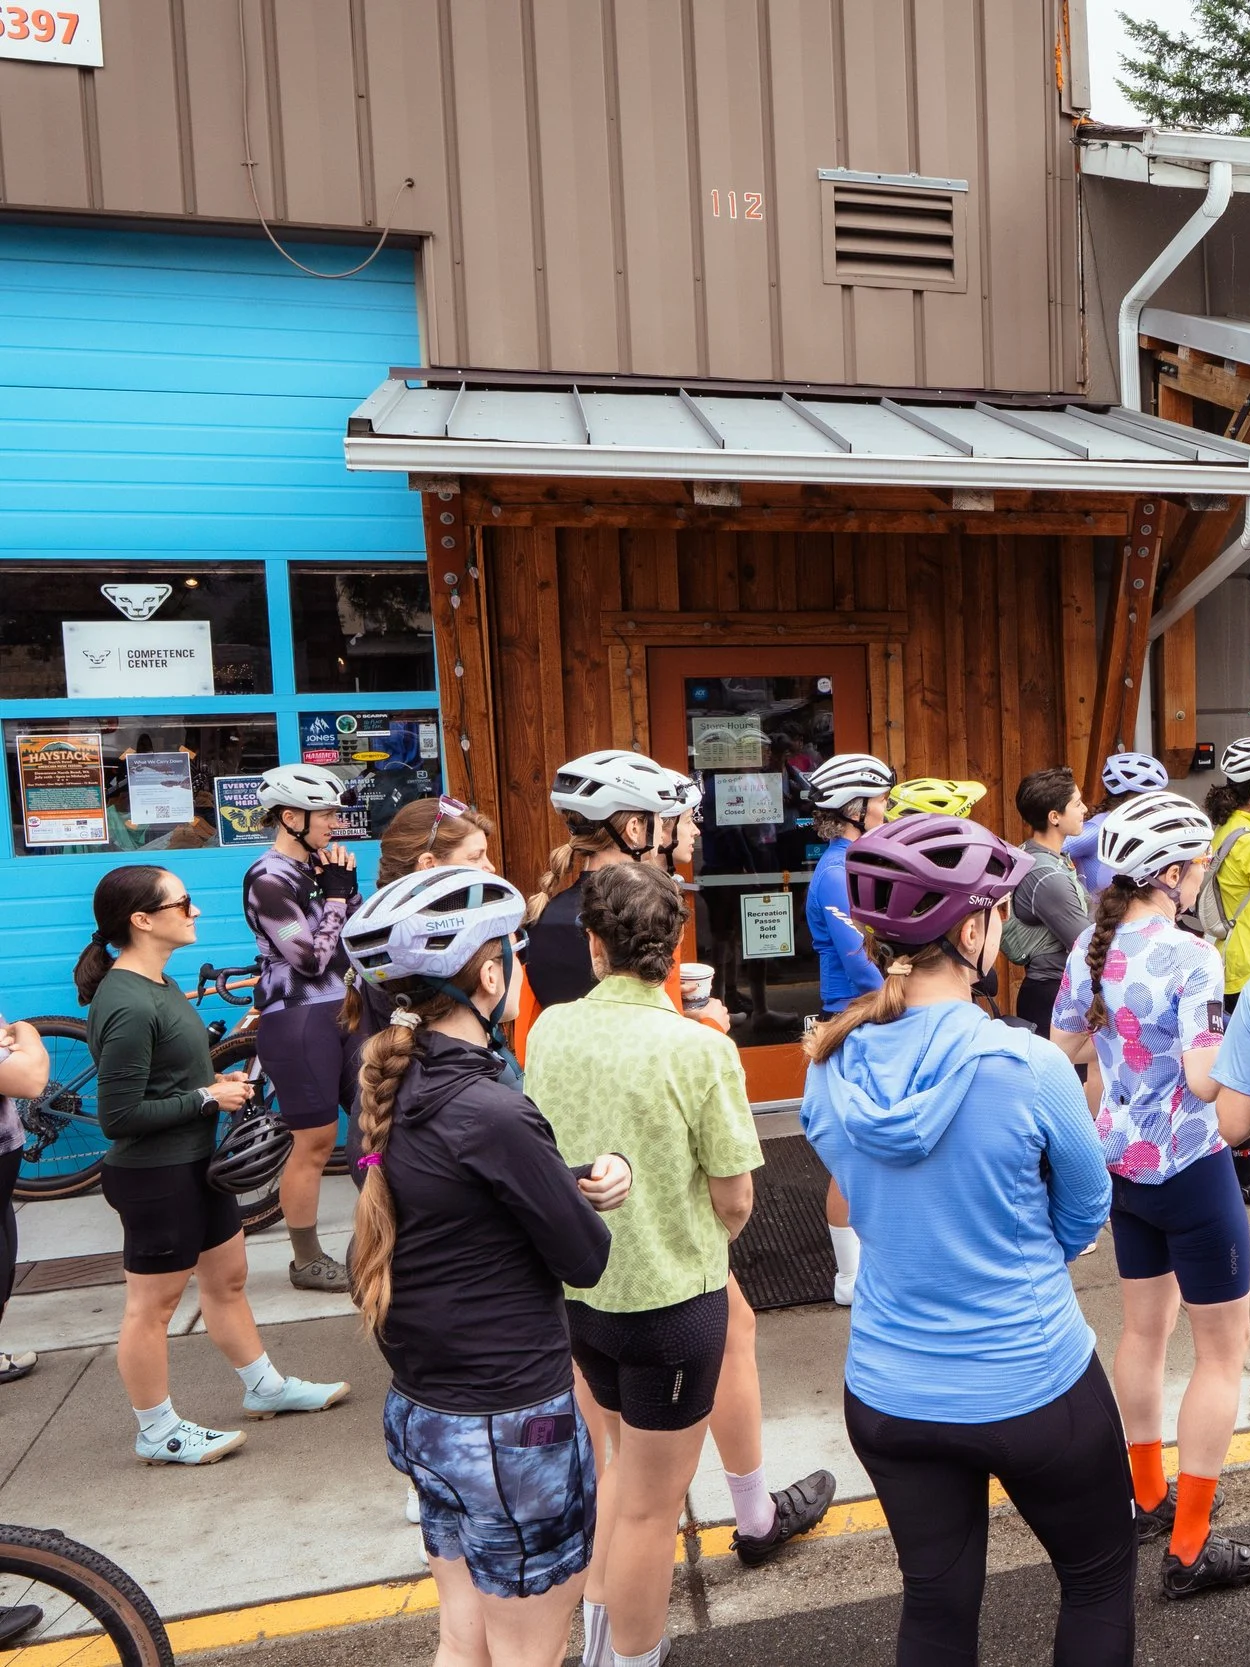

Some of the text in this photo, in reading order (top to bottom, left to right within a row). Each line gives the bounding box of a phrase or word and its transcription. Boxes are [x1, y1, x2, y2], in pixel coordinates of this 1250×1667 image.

[711, 189, 763, 220] 112
[127, 649, 195, 659] COMPETENCE
[128, 659, 168, 669] CENTER
[727, 722, 755, 730] Hours
[29, 751, 92, 763] HAYSTACK
[305, 751, 337, 759] HAMMER
[222, 782, 261, 790] EVERYO
[223, 793, 257, 801] WELCO
[968, 895, 994, 907] SMITH
[425, 917, 465, 931] SMITH
[241, 1014, 260, 1029] T
[210, 1036, 258, 1058] CHWALB
